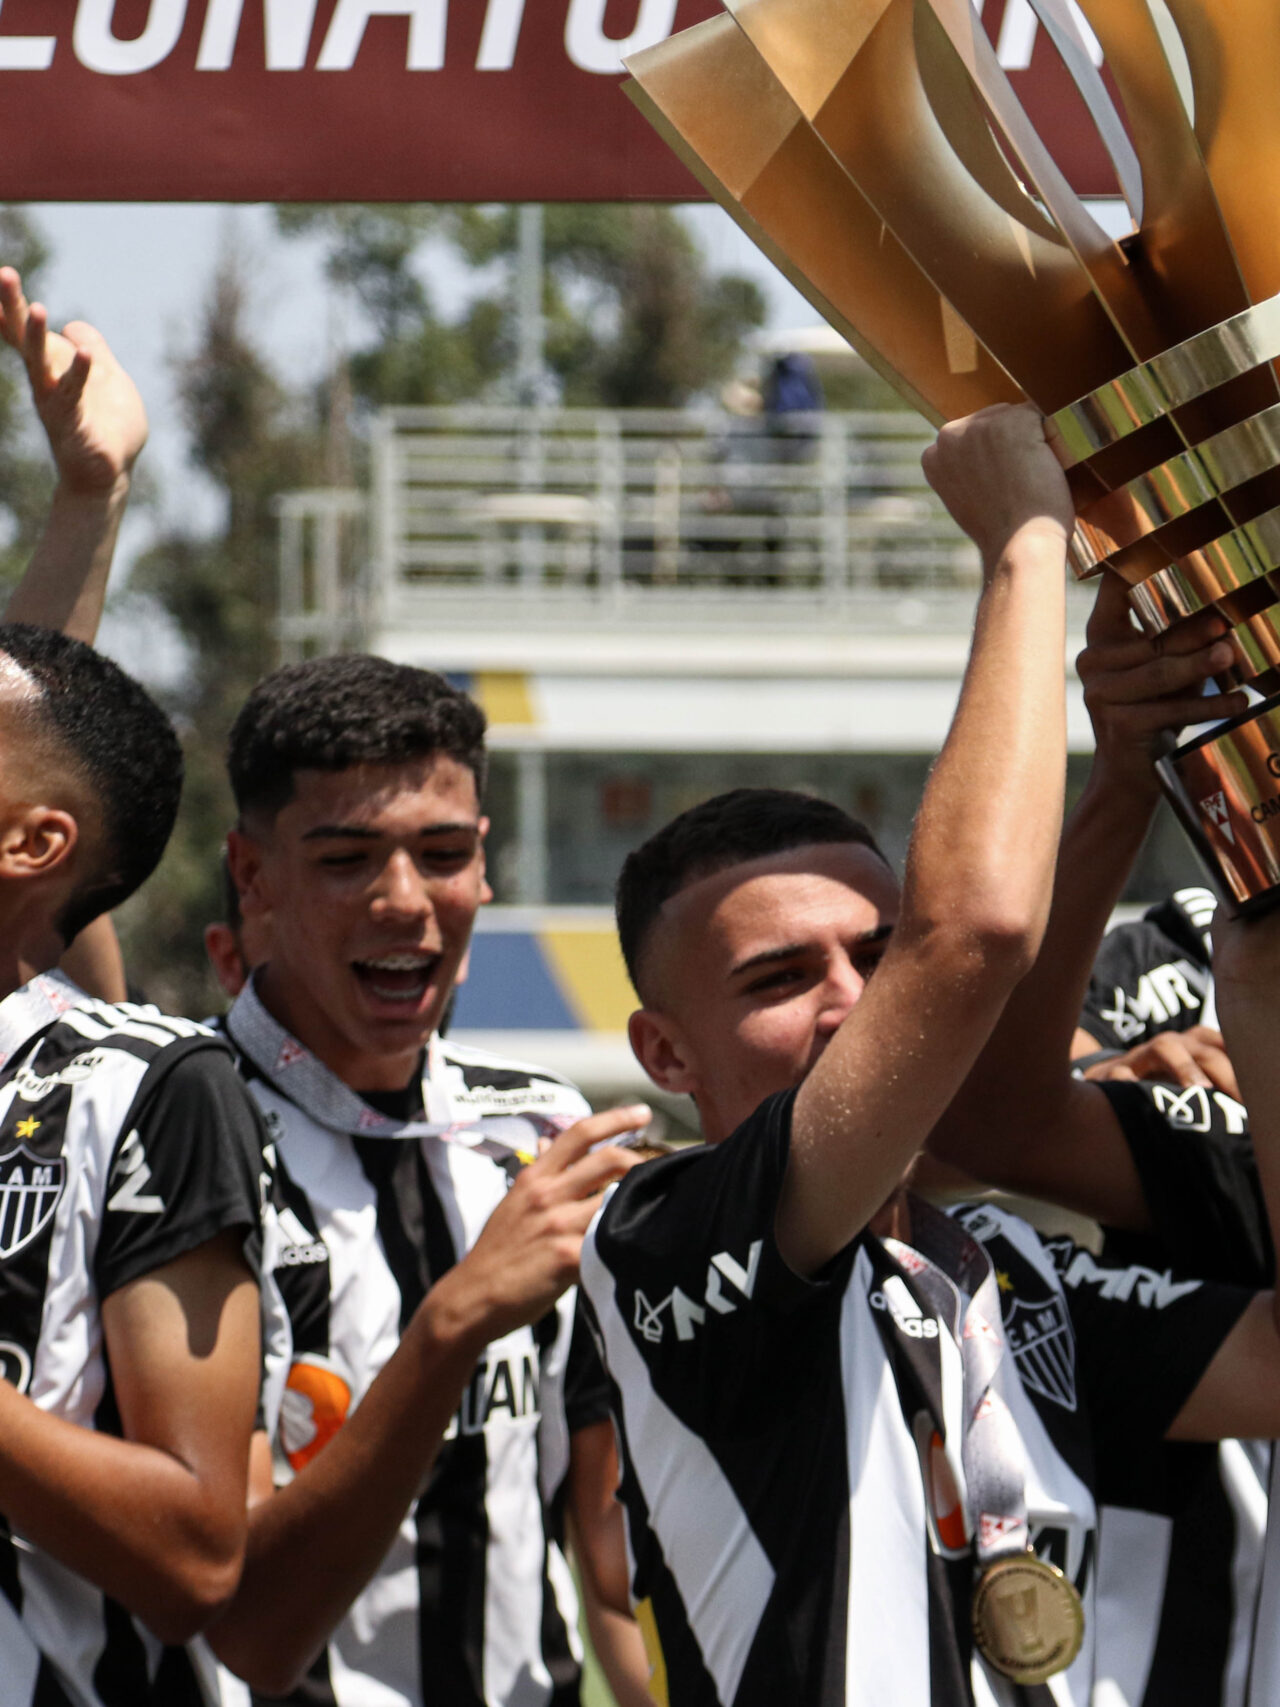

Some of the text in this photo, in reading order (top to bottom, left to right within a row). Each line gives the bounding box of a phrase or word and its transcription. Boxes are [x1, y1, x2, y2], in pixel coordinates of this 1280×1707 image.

[0, 1165, 53, 1186] AM
[1064, 1251, 1204, 1310] MRV
[1006, 1310, 1058, 1348] CAM
